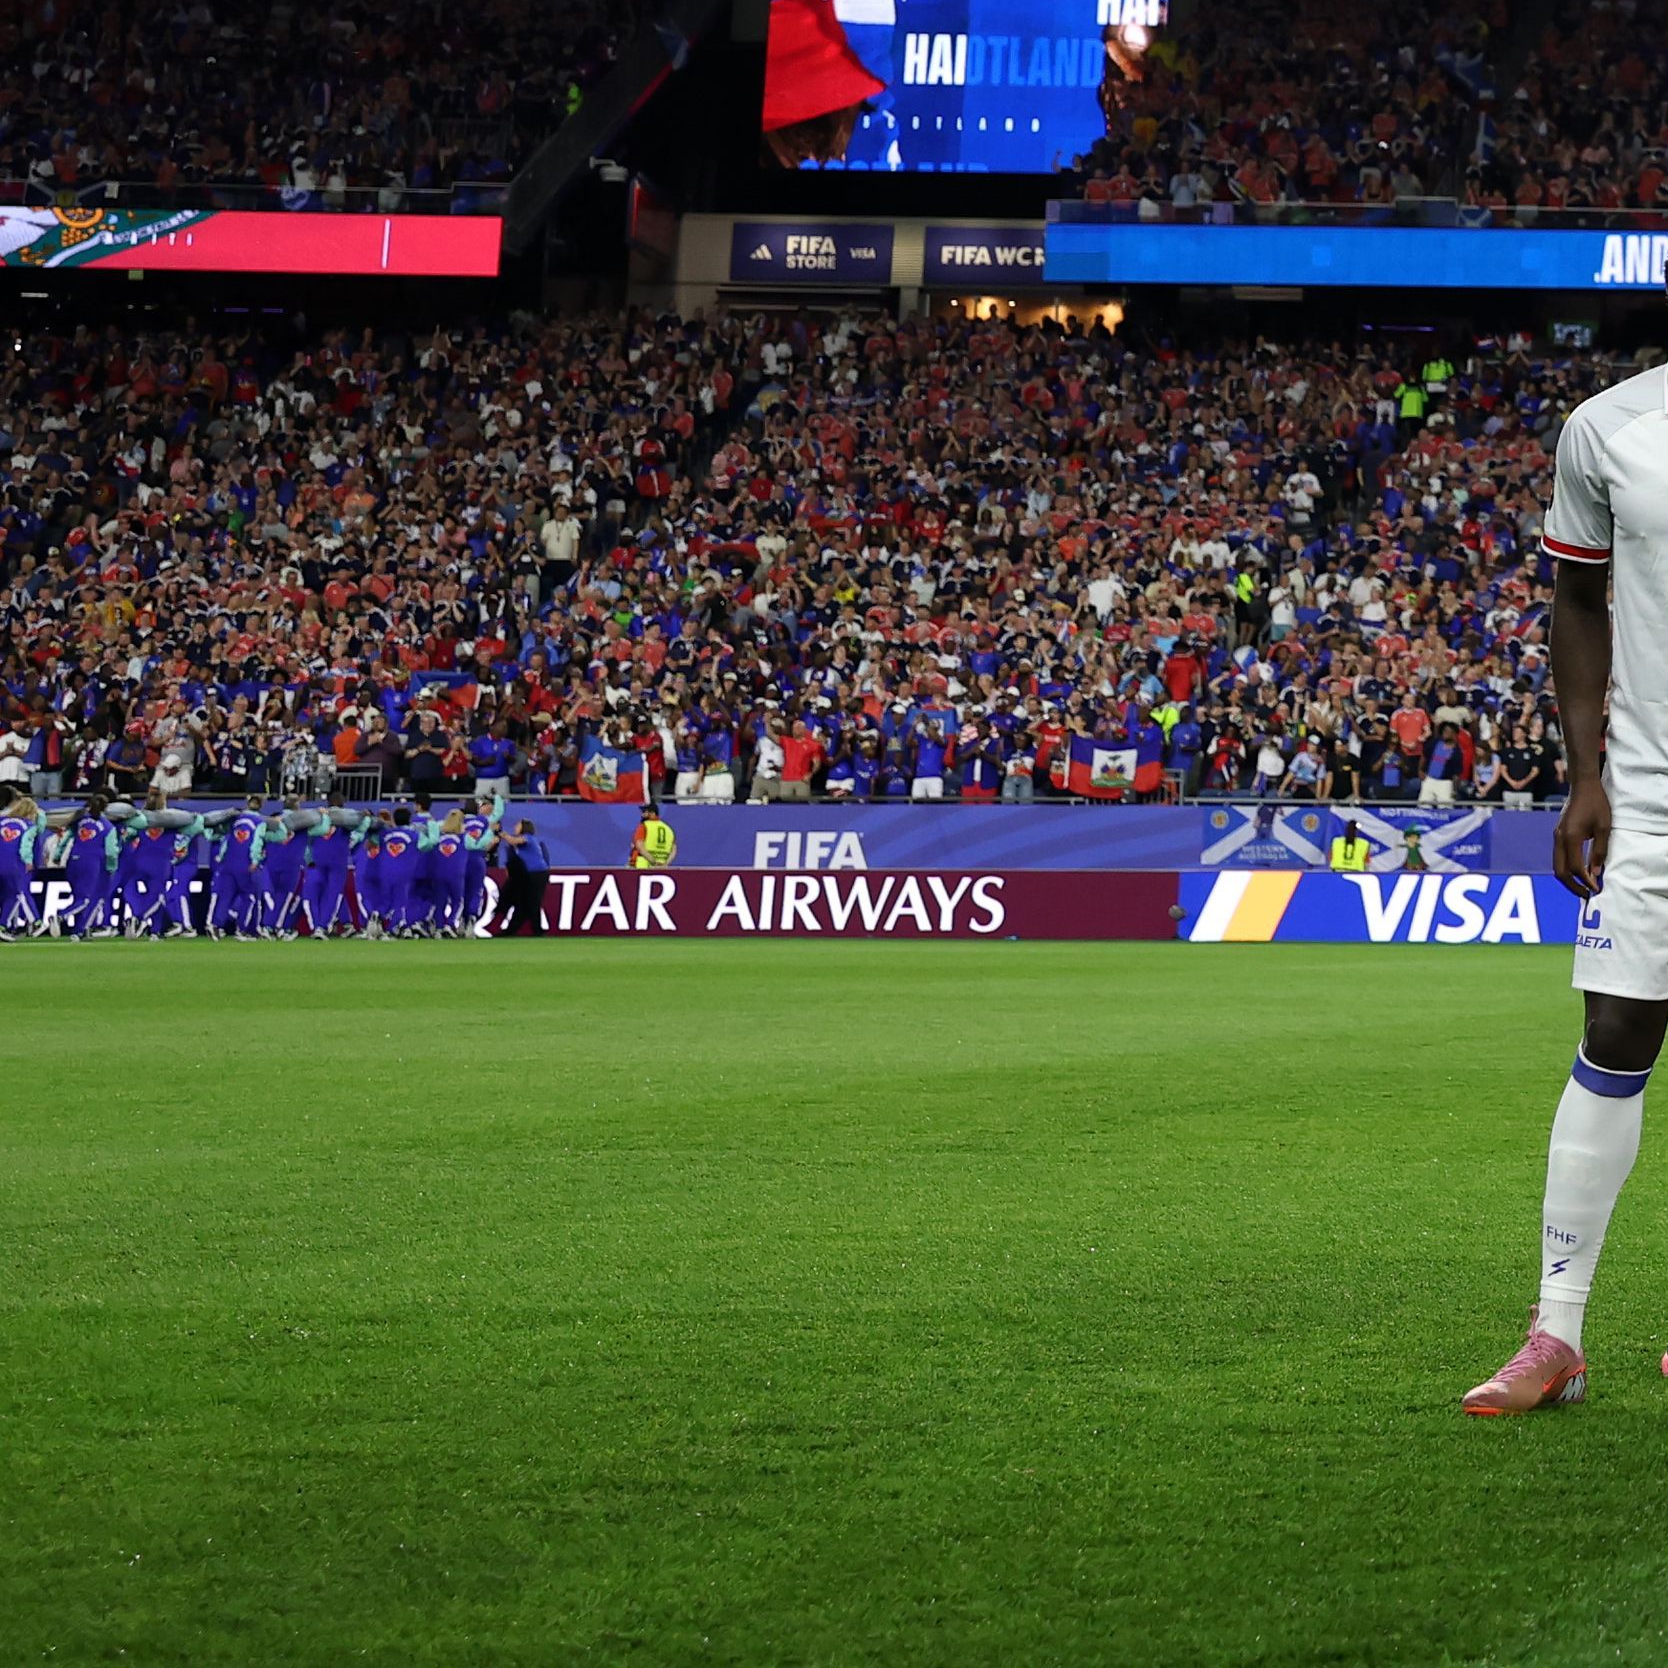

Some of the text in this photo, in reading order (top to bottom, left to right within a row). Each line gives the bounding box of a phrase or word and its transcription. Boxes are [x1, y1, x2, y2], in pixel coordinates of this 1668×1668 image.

[786, 236, 836, 254] FIFA
[941, 245, 992, 266] FIFA
[786, 254, 836, 270] STORE
[754, 832, 869, 870] FIFA
[706, 875, 1005, 933] AIRWAYS
[1342, 874, 1541, 943] VISA
[1546, 1225, 1577, 1246] FHF
